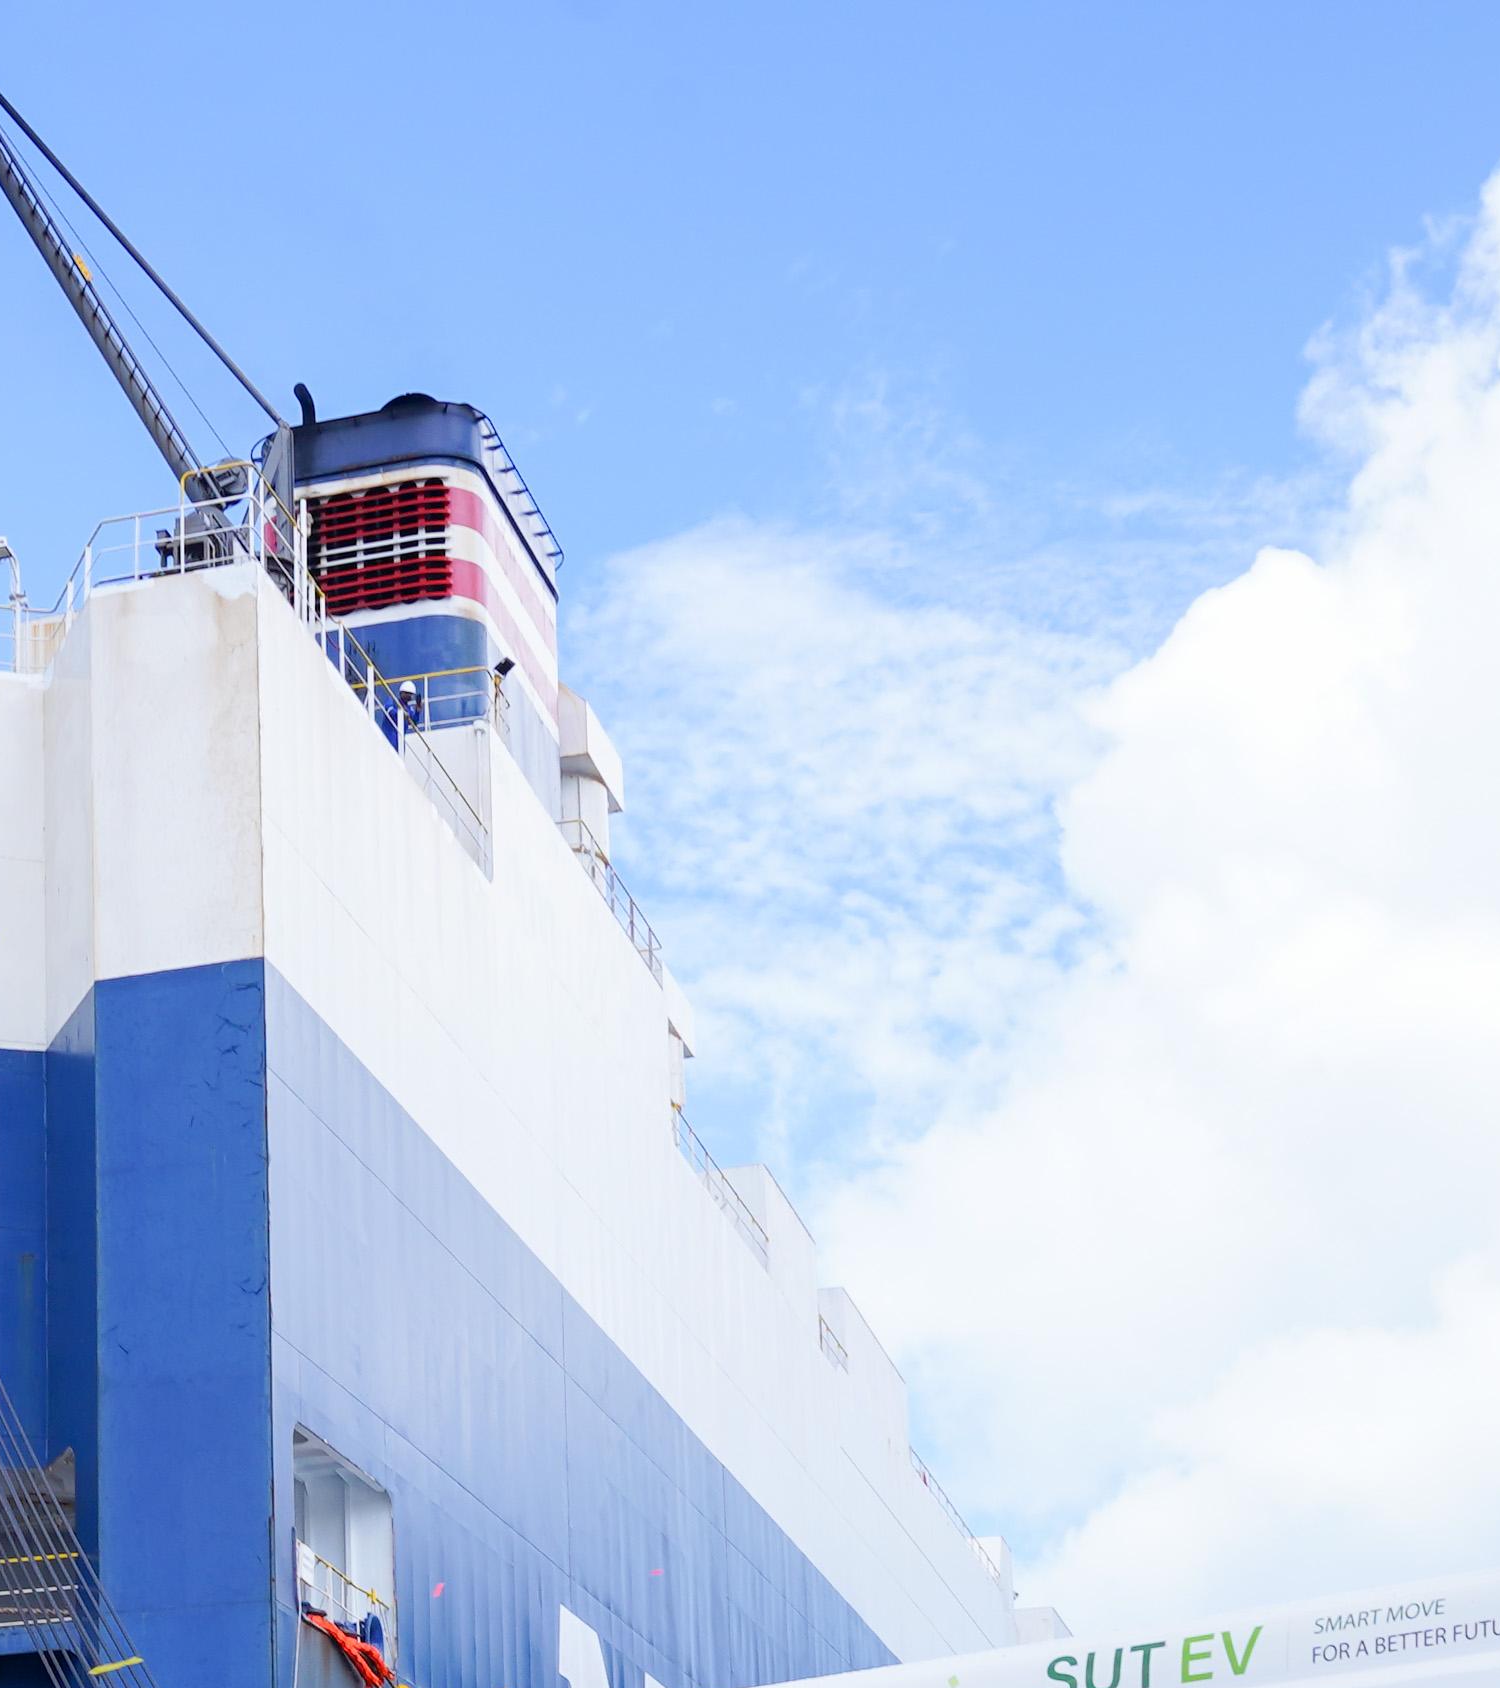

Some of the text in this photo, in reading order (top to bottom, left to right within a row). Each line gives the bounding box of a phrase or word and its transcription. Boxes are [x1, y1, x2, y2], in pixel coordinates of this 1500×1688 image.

[1312, 1598, 1447, 1636] SMART MOVE
[1180, 1625, 1264, 1684] EV
[1311, 1642, 1354, 1664] FOR
[1355, 1640, 1370, 1658] A
[1375, 1627, 1449, 1655] BETTER
